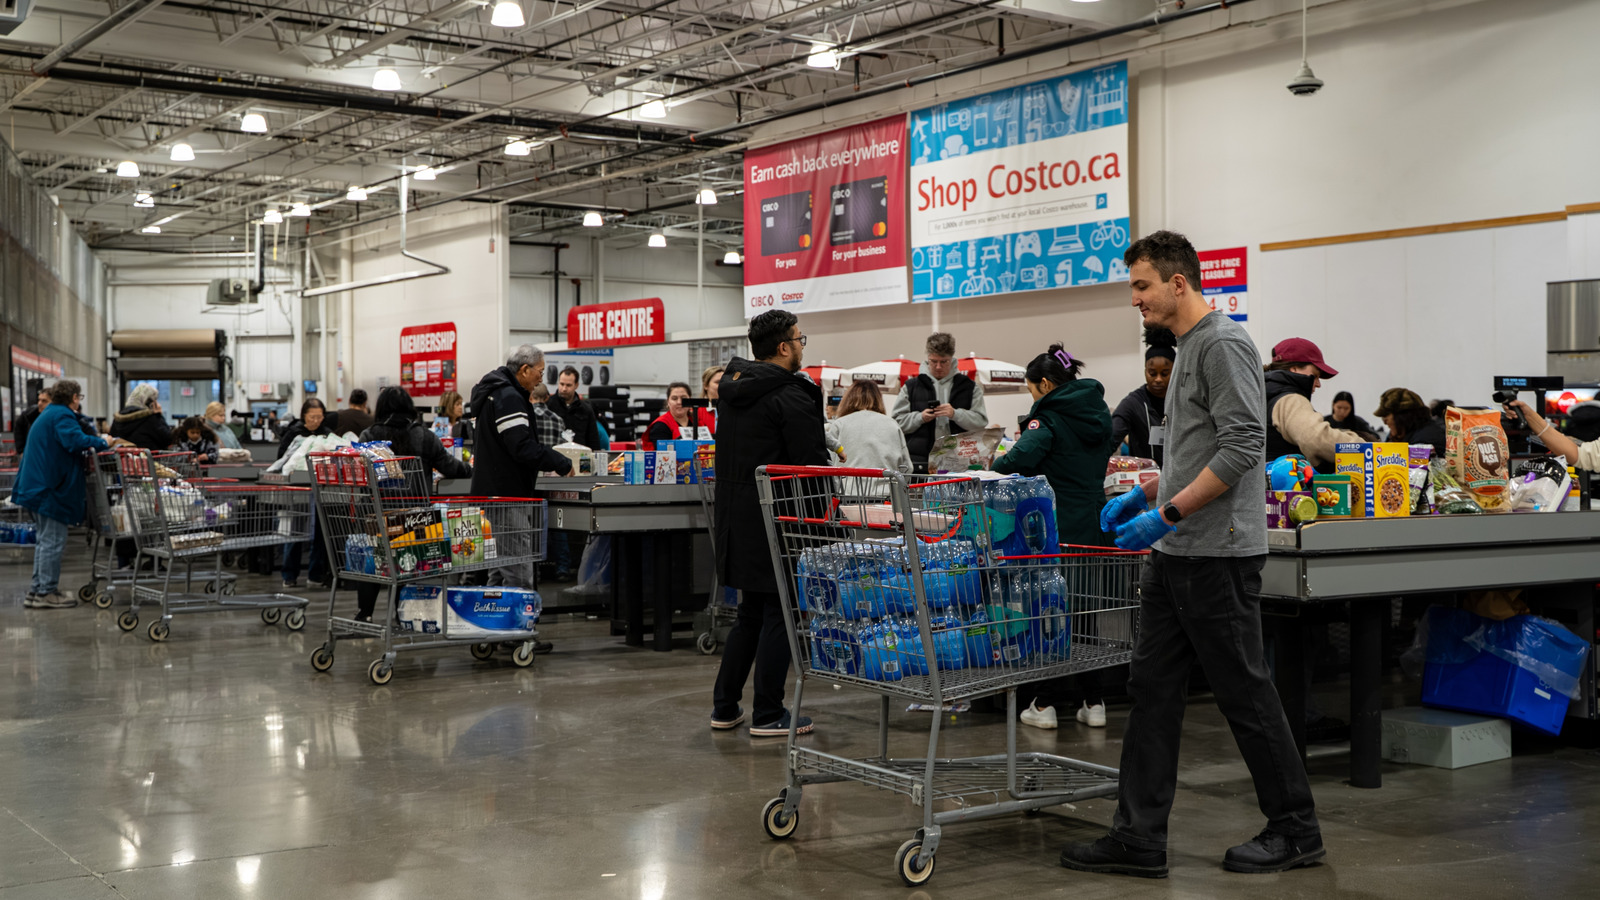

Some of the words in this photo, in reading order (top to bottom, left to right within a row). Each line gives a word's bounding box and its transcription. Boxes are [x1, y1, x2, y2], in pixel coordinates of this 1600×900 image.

[751, 165, 774, 184] Earn
[776, 157, 800, 179] cash
[802, 150, 829, 173] back
[830, 139, 899, 167] everywhere
[917, 176, 977, 212] Shop
[987, 152, 1121, 199] Costco.ca
[762, 203, 774, 213] CIBC
[1028, 208, 1041, 216] local
[1042, 206, 1059, 214] Costco
[832, 250, 843, 261] For
[843, 248, 857, 261] your
[857, 245, 886, 257] business
[775, 258, 785, 269] For
[785, 258, 797, 269] you
[1200, 259, 1220, 270] BER'S
[1221, 257, 1241, 267] PRICE
[1205, 268, 1236, 280] GASOLINE
[750, 296, 767, 307] CIBC
[781, 292, 804, 301] COSTCO
[577, 311, 604, 341] TIRE
[606, 306, 654, 339] CENTRE
[401, 330, 456, 354] MEMBERSHIP
[853, 373, 886, 381] KIRKLAND
[992, 370, 1025, 378] KIRKLAND
[1478, 442, 1496, 455] QUE
[1376, 453, 1407, 468] Shreddies
[1481, 454, 1499, 464] PASA
[1336, 463, 1364, 474] Shreddies
[1365, 448, 1374, 505] JUMBO
[461, 520, 476, 529] All-
[453, 527, 478, 537] Bran
[473, 602, 491, 613] Bath
[491, 602, 511, 612] Tissue
